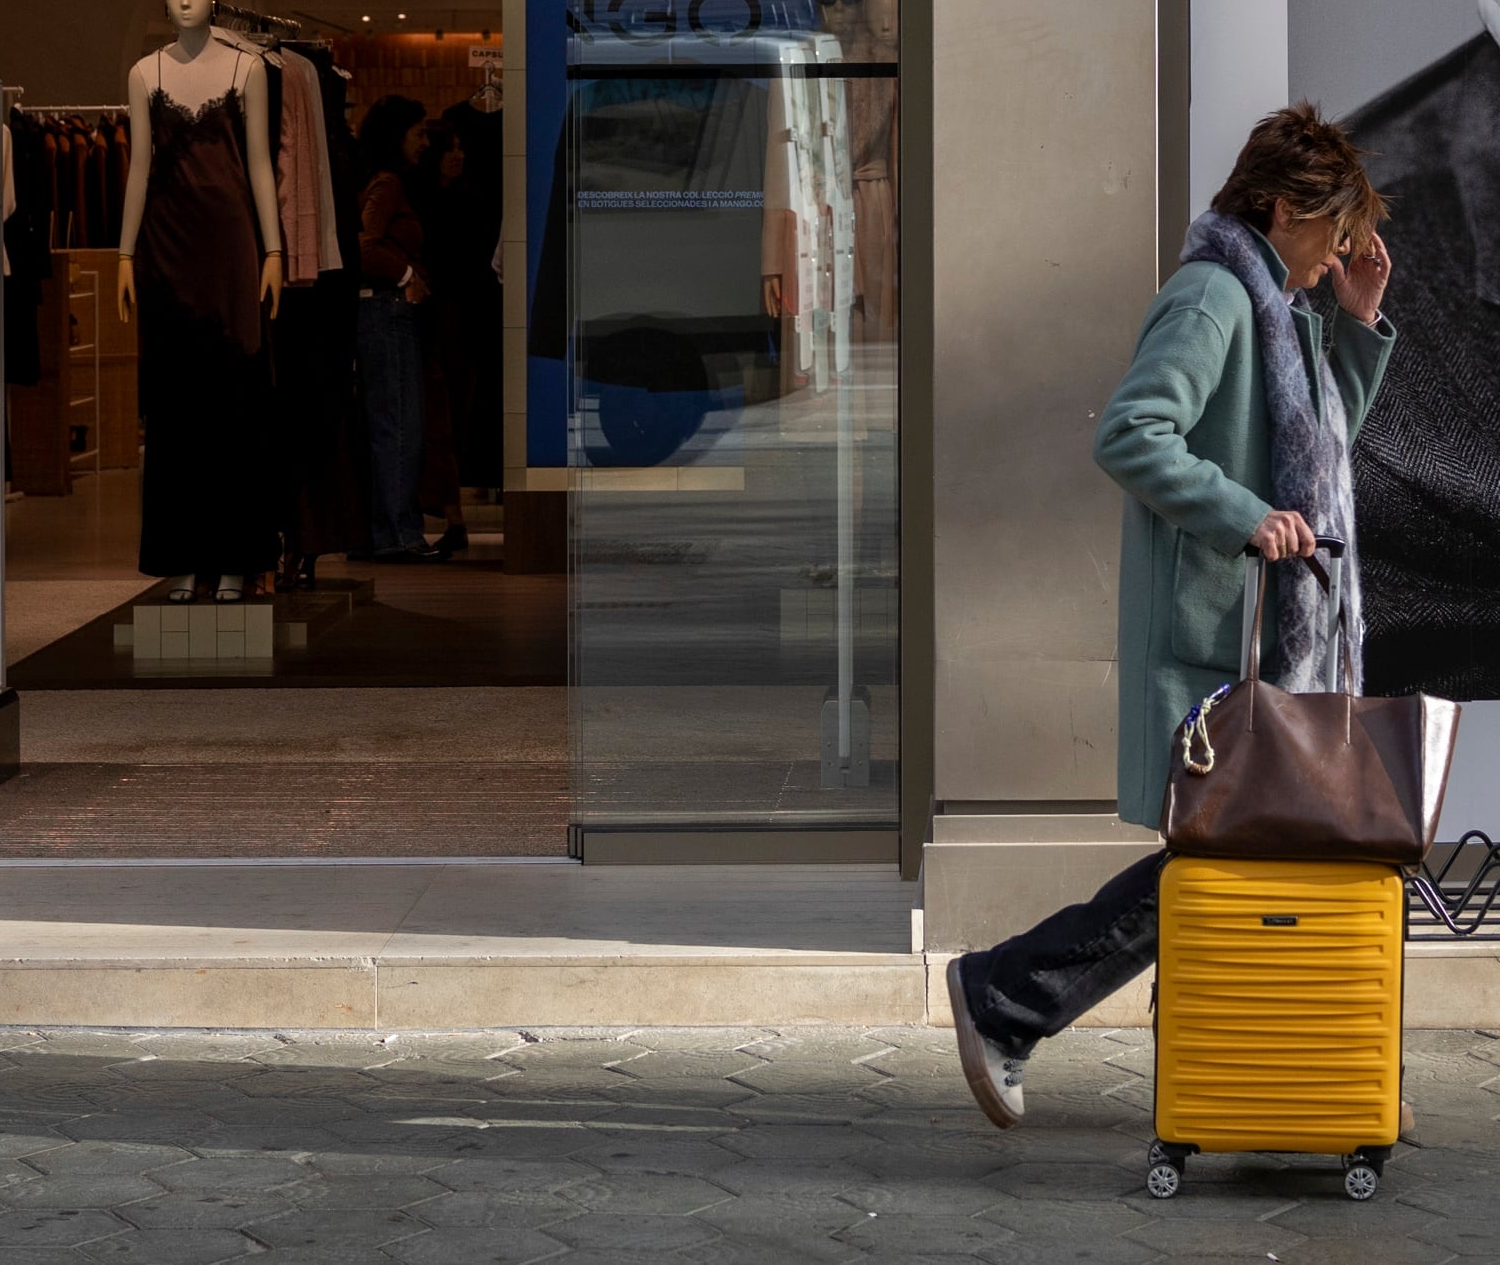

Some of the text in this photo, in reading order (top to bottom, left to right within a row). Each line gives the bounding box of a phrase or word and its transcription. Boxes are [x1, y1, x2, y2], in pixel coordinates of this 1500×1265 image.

[578, 191, 633, 199] DESCOBREIX
[634, 191, 645, 199] LA
[646, 191, 682, 199] NOSTRA
[591, 200, 634, 208] BOTIGUES
[635, 200, 707, 208] SELECCIONADES
[712, 200, 719, 208] A
